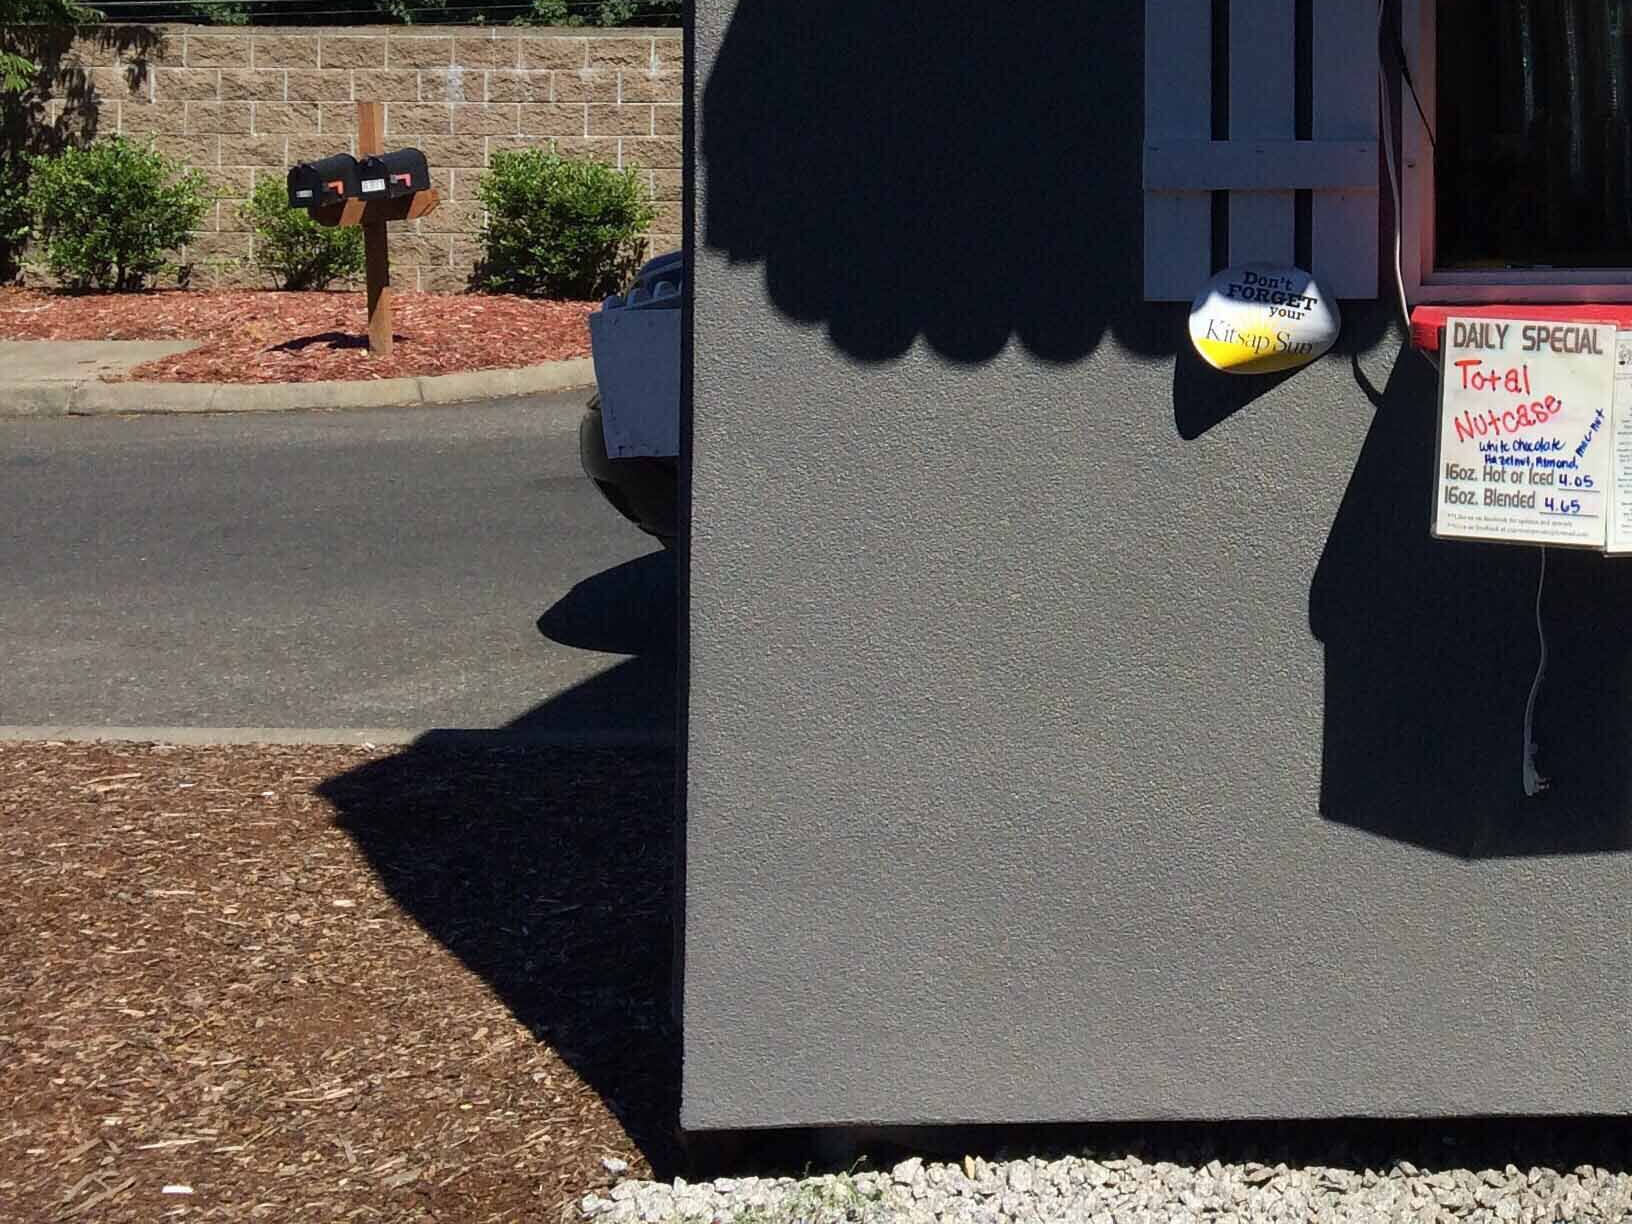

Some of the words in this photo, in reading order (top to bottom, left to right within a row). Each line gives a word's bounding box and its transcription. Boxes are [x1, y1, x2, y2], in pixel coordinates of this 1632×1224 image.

[1243, 271, 1295, 292] Don't
[1226, 283, 1318, 311] FORGET
[1268, 305, 1305, 321] your
[1205, 318, 1270, 355] Kitsap
[1272, 330, 1314, 354] Sun
[1453, 321, 1510, 350] DAILY
[1521, 324, 1604, 355] SPECIAL
[1454, 359, 1532, 396] Total
[1453, 393, 1563, 443] Nutcase
[1444, 462, 1478, 482] 16oz.
[1482, 464, 1506, 483] Hot
[1510, 470, 1525, 484] or
[1528, 467, 1556, 487] Iced
[1558, 473, 1594, 489] 4.05
[1443, 485, 1479, 506] 16oz.
[1483, 487, 1536, 510] Blended
[1544, 496, 1581, 514] 4.65
